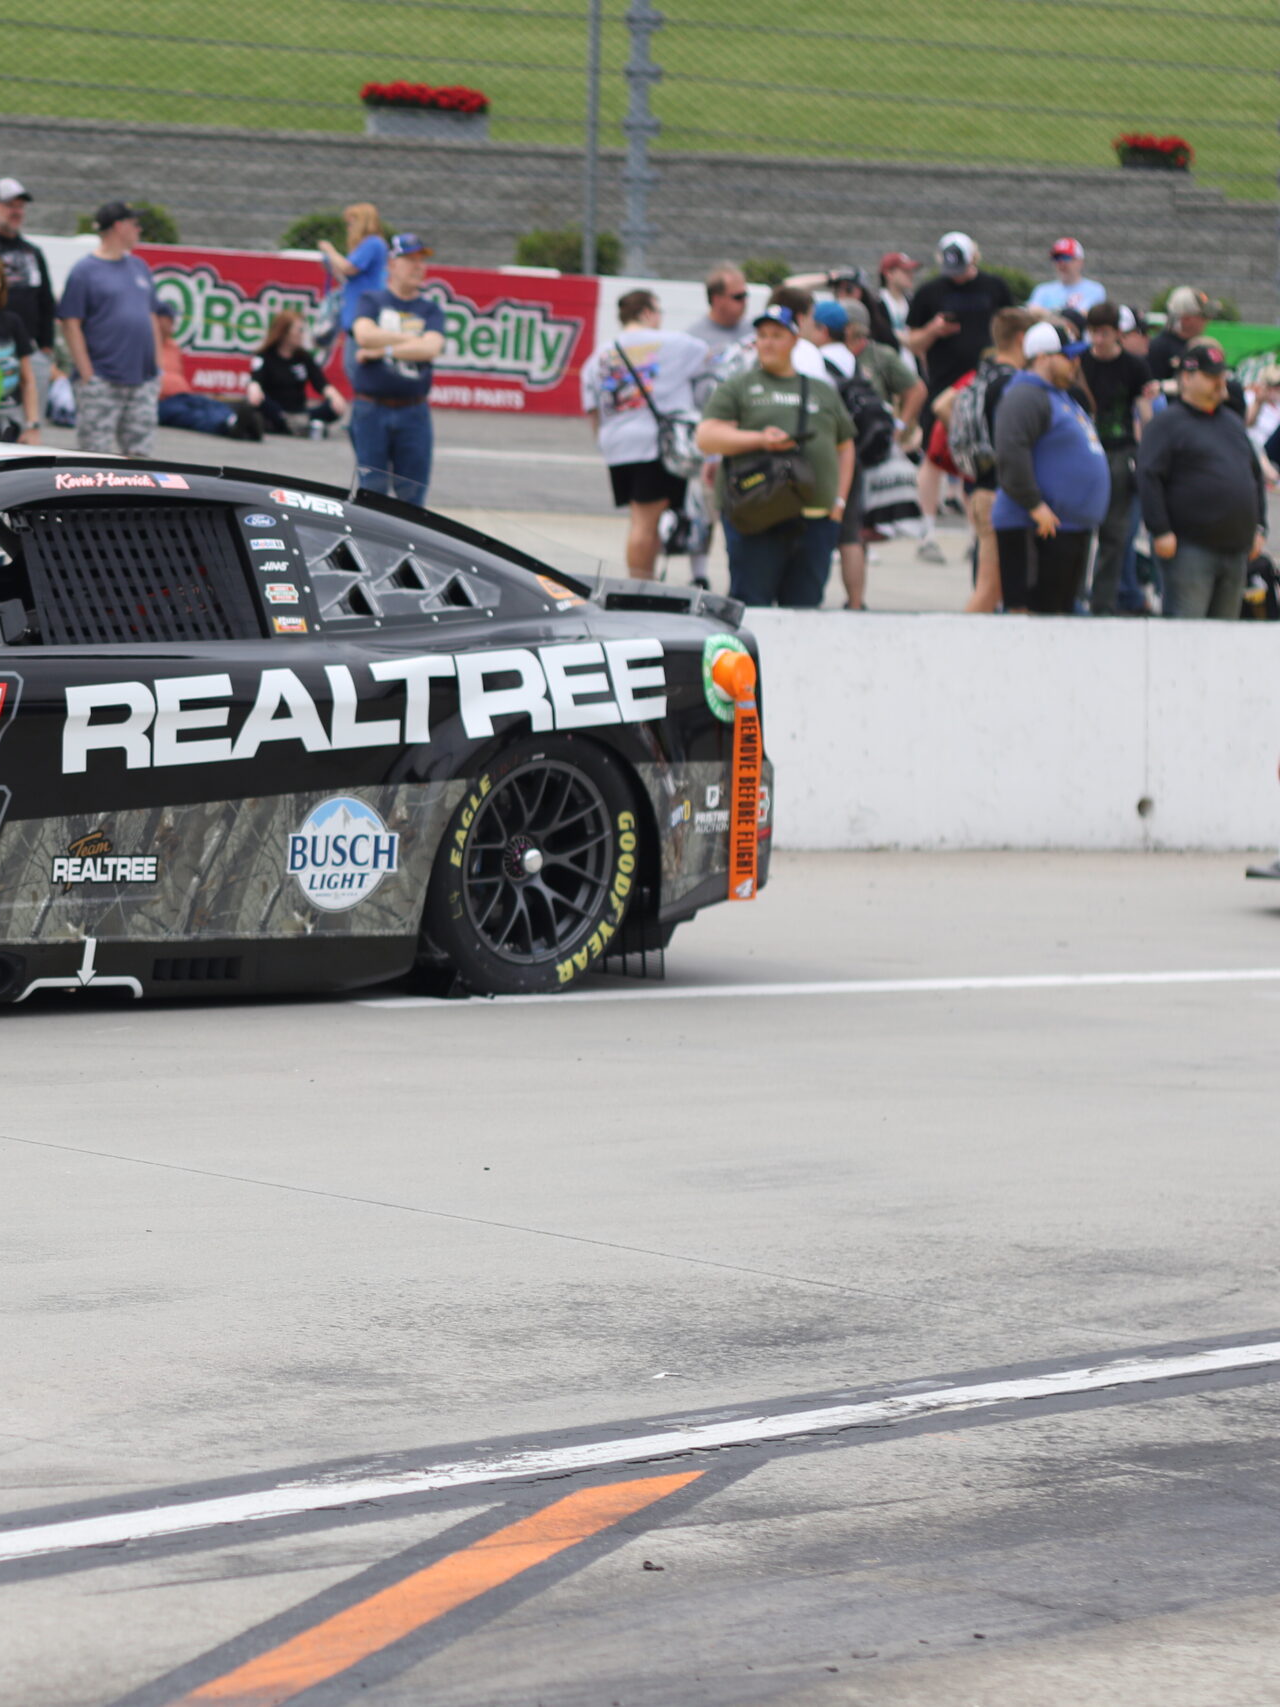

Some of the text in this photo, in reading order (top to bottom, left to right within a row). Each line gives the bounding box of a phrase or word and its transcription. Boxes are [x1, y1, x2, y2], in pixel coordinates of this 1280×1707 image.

[155, 277, 320, 356] O'Rei
[432, 293, 564, 372] 'Reilly
[474, 387, 525, 409] PARTS
[61, 638, 668, 774] REALTREE
[735, 716, 757, 876] REMOVE BEFORE FLIGHT
[450, 773, 492, 868] EAGLE
[68, 831, 112, 859] Team
[289, 833, 397, 872] BUSCH
[52, 856, 158, 883] REALTREE
[308, 872, 370, 891] LIGHT
[734, 877, 755, 899] 4
